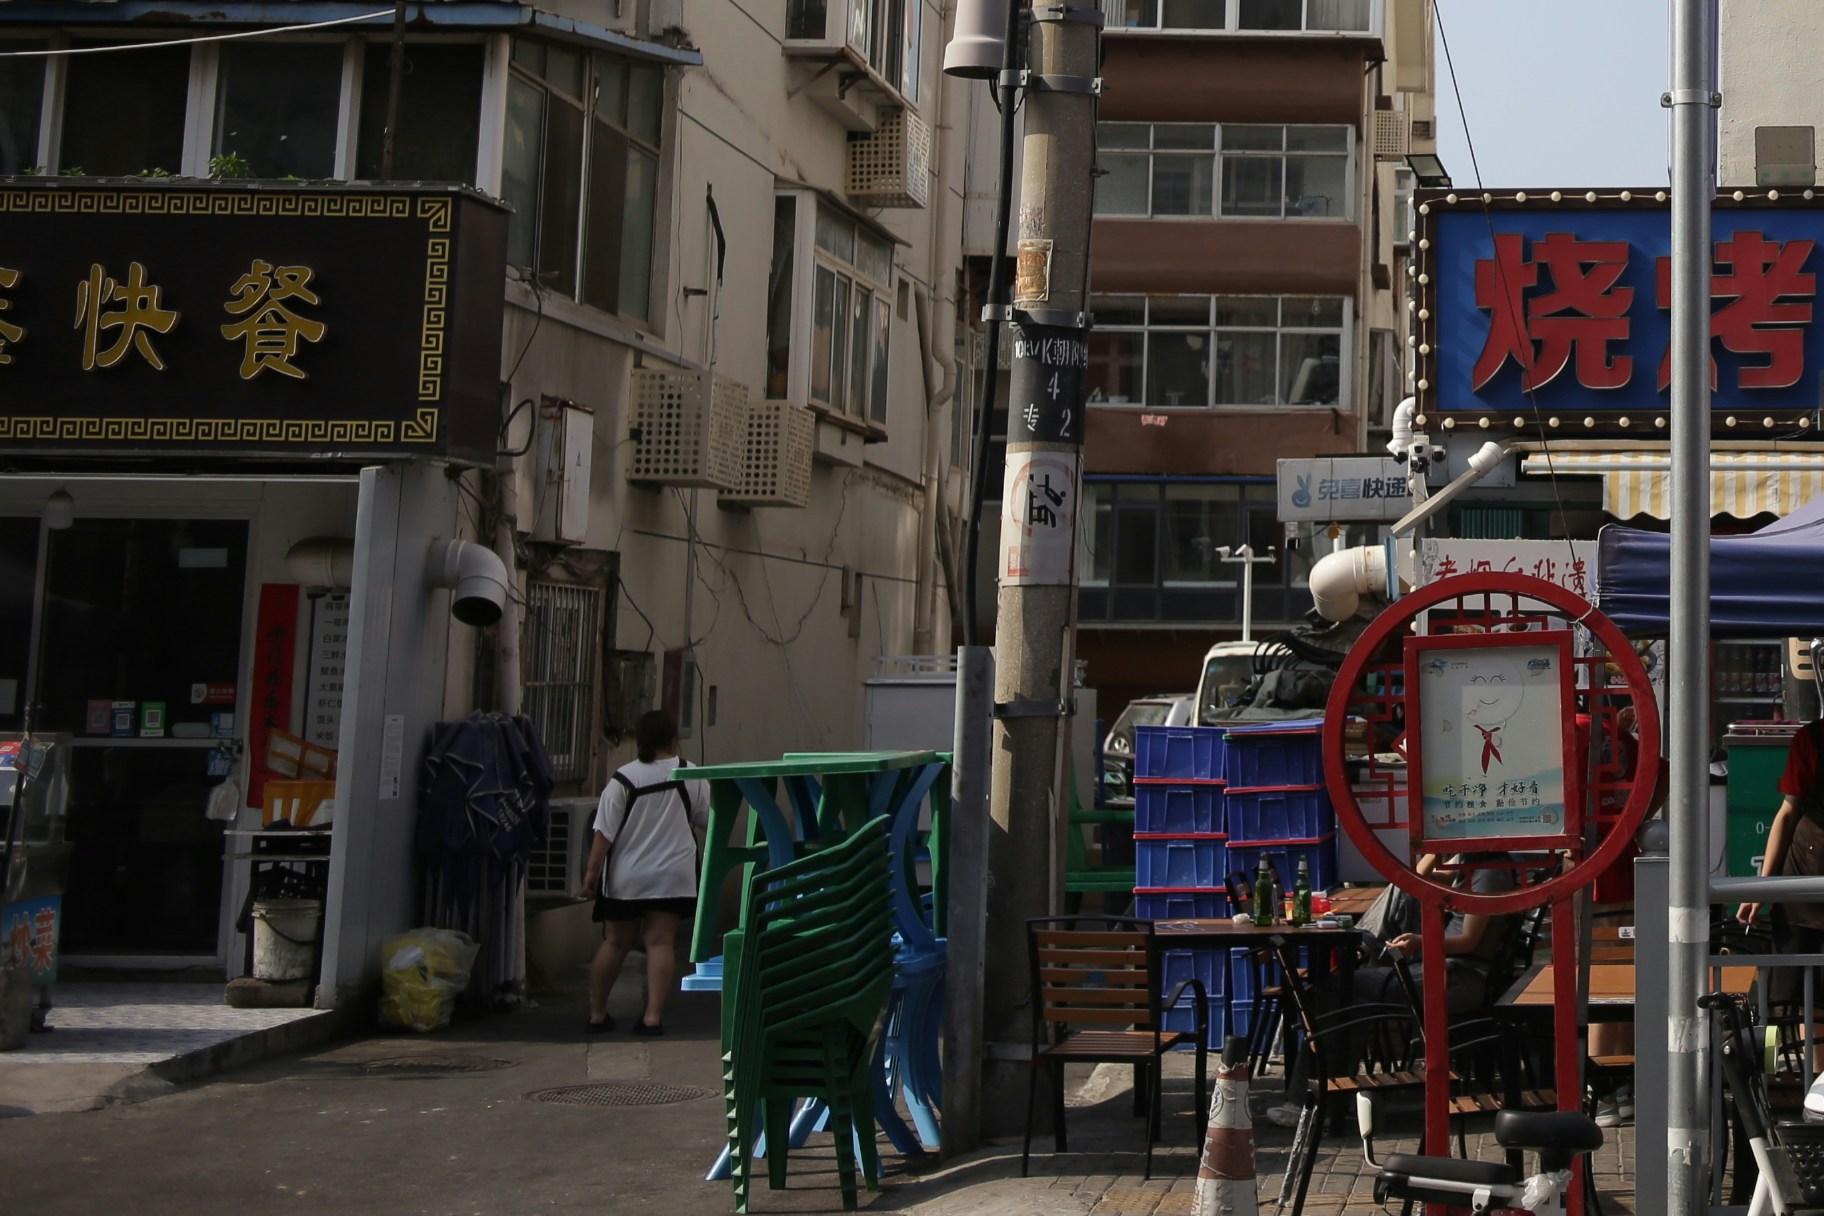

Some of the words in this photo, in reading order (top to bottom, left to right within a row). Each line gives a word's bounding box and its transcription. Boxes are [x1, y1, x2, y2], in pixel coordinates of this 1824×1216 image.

[0, 258, 328, 380] 快餐
[1472, 230, 1817, 393] 烧烤
[1046, 371, 1060, 400] 4
[1060, 408, 1071, 437] 2
[1442, 783, 1488, 798] 吃干净
[1496, 780, 1539, 796] 才好看
